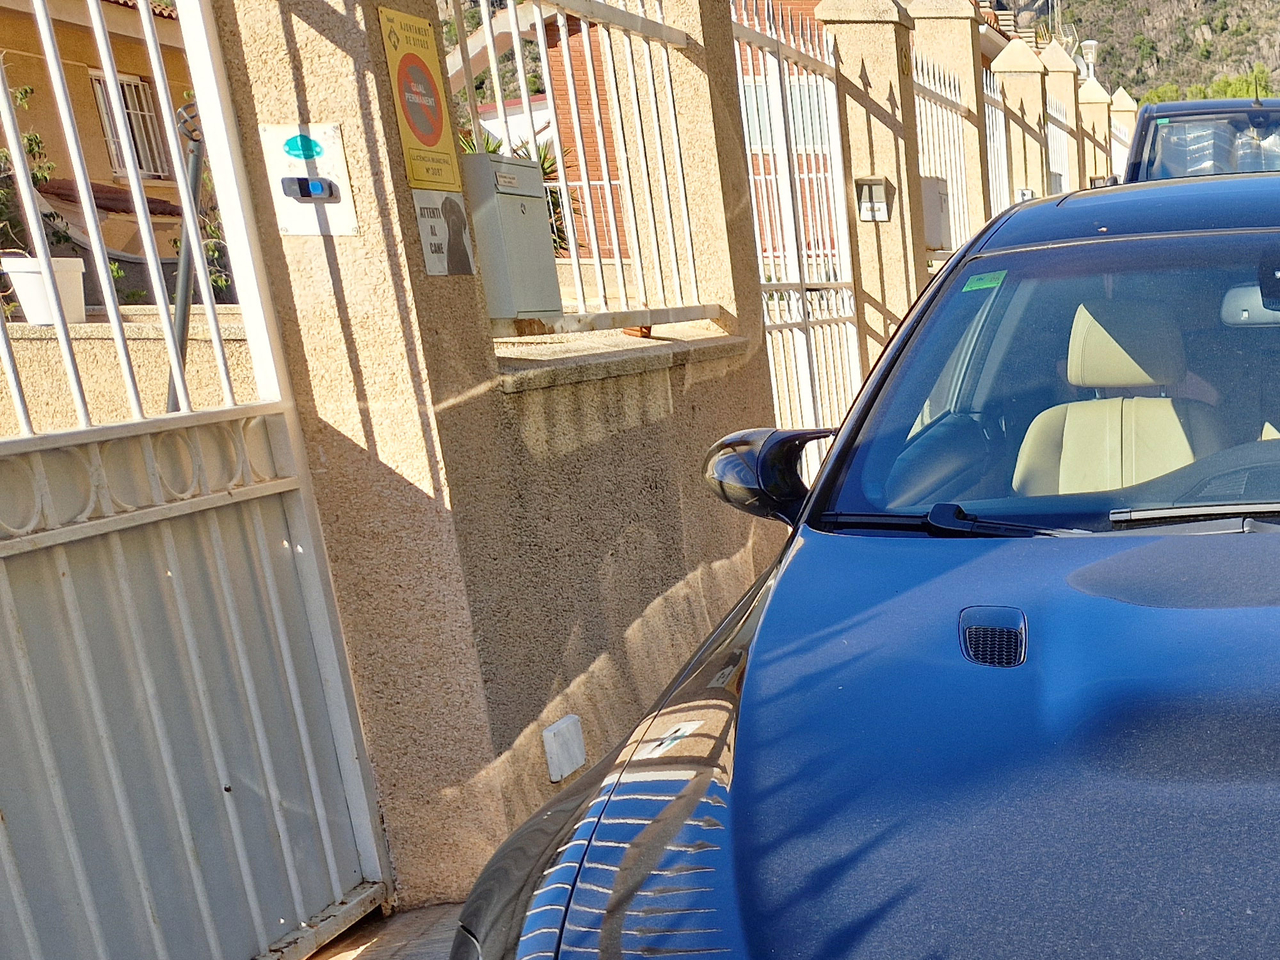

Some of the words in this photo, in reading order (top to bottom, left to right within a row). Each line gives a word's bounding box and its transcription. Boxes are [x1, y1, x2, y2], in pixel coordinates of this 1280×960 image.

[400, 21, 430, 37] AJUNTAMENT
[405, 35, 412, 46] DE
[405, 92, 435, 107] PERMANENT
[420, 206, 441, 219] ATTENTI
[430, 225, 437, 237] AL
[430, 242, 444, 254] CANE
